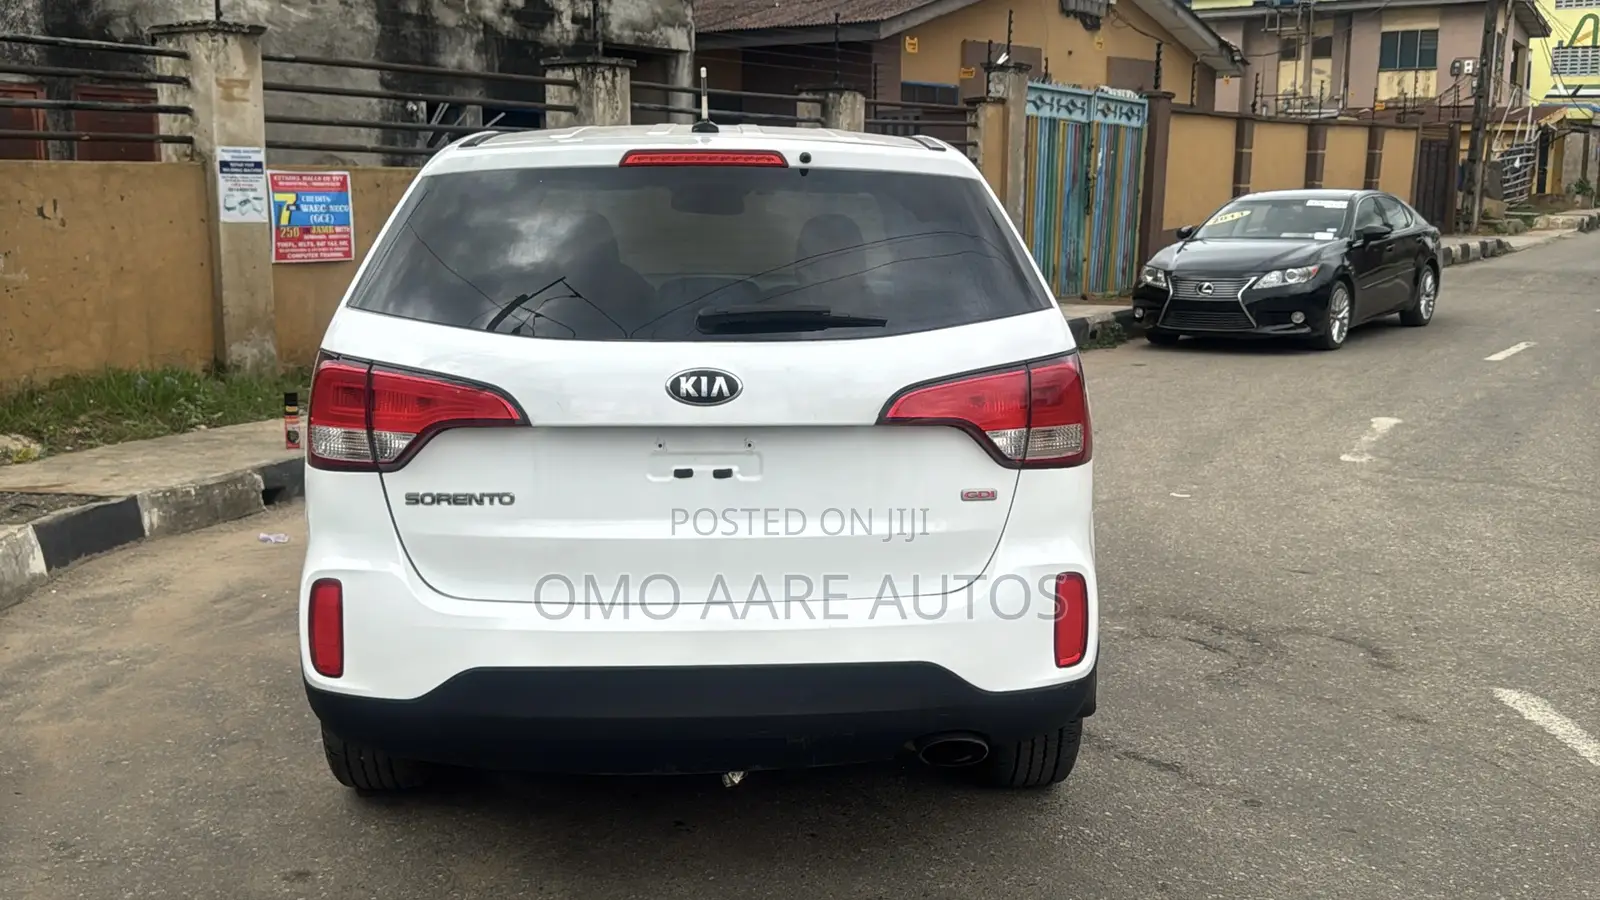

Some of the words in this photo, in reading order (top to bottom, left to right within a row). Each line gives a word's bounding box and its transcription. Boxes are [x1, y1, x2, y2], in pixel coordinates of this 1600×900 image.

[274, 193, 297, 225] 7
[300, 204, 327, 213] WAEC
[280, 227, 300, 238] 250
[679, 375, 732, 398] KIA
[405, 492, 515, 506] SORENTO
[963, 490, 995, 499] GDI
